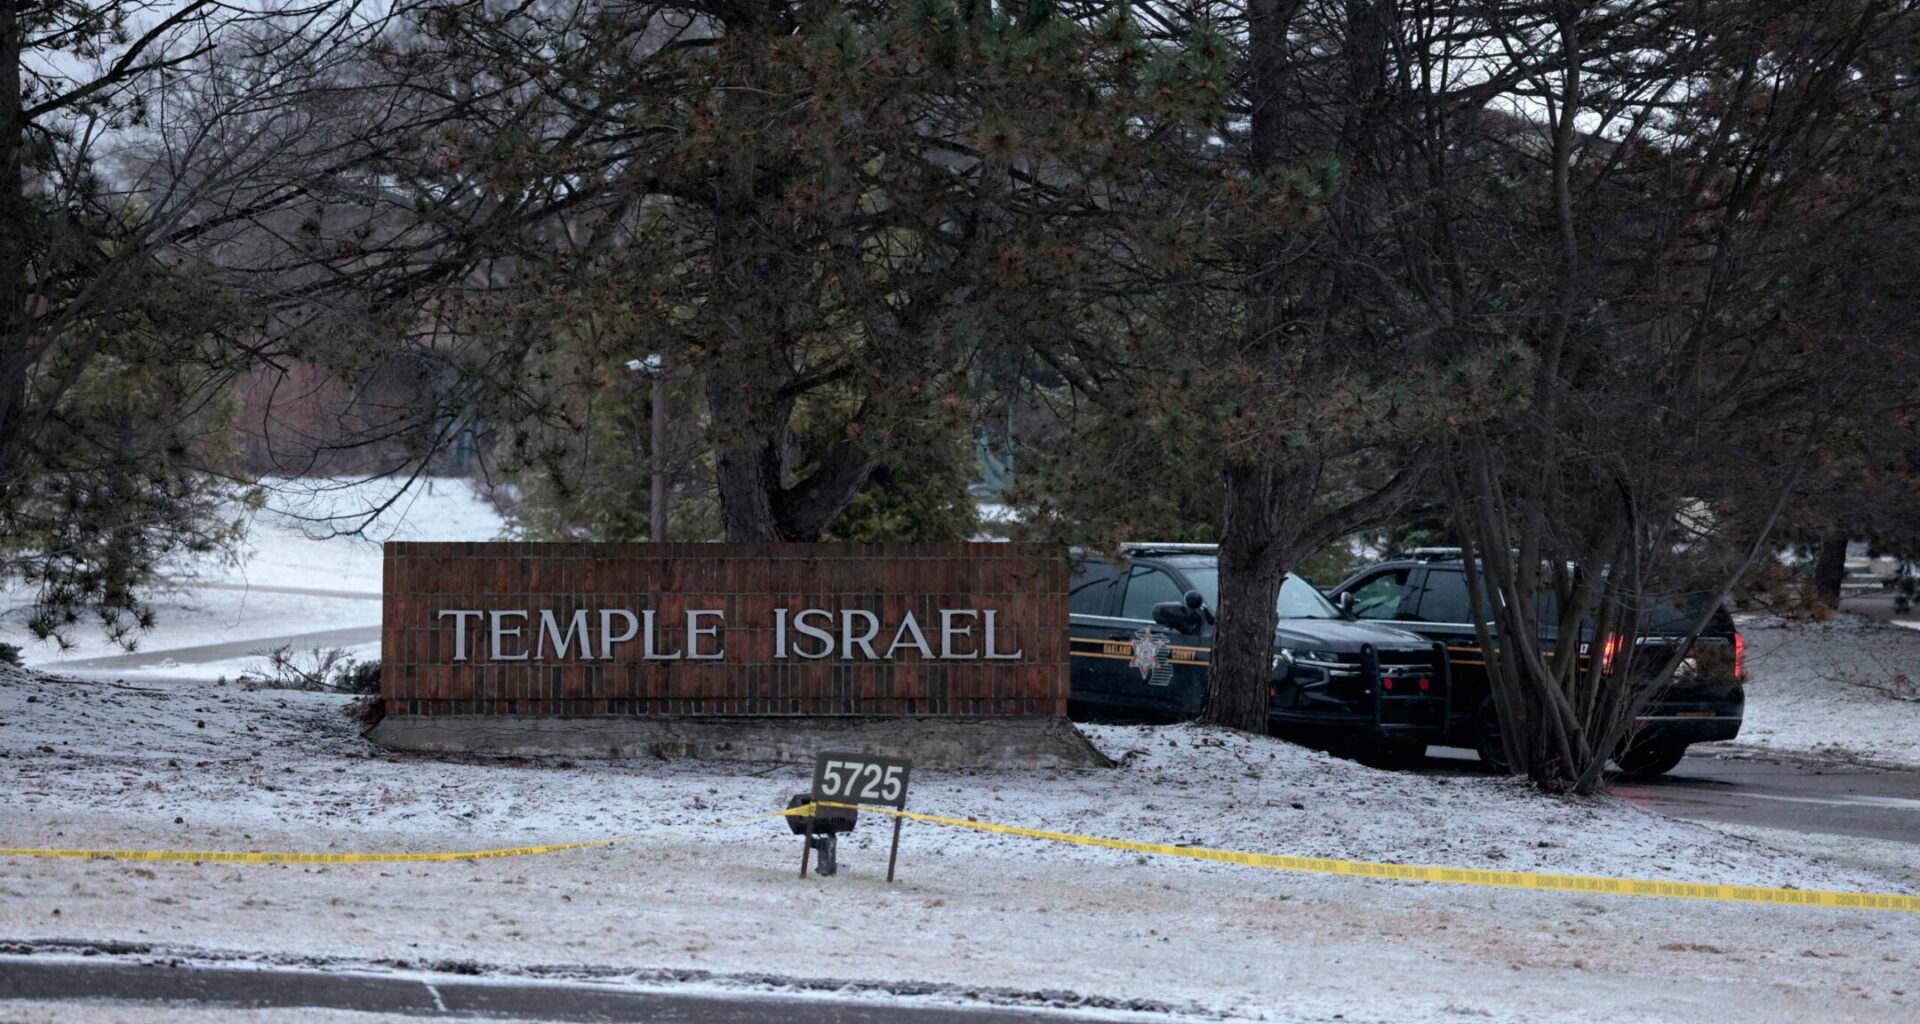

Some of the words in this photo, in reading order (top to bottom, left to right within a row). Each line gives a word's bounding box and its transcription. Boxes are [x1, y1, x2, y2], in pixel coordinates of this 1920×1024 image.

[438, 609, 725, 660] TEMPLE
[773, 608, 1022, 659] ISRAEL
[1103, 643, 1132, 656] OAKLAND
[1171, 649, 1197, 661] COUNTY
[821, 760, 903, 801] 5725
